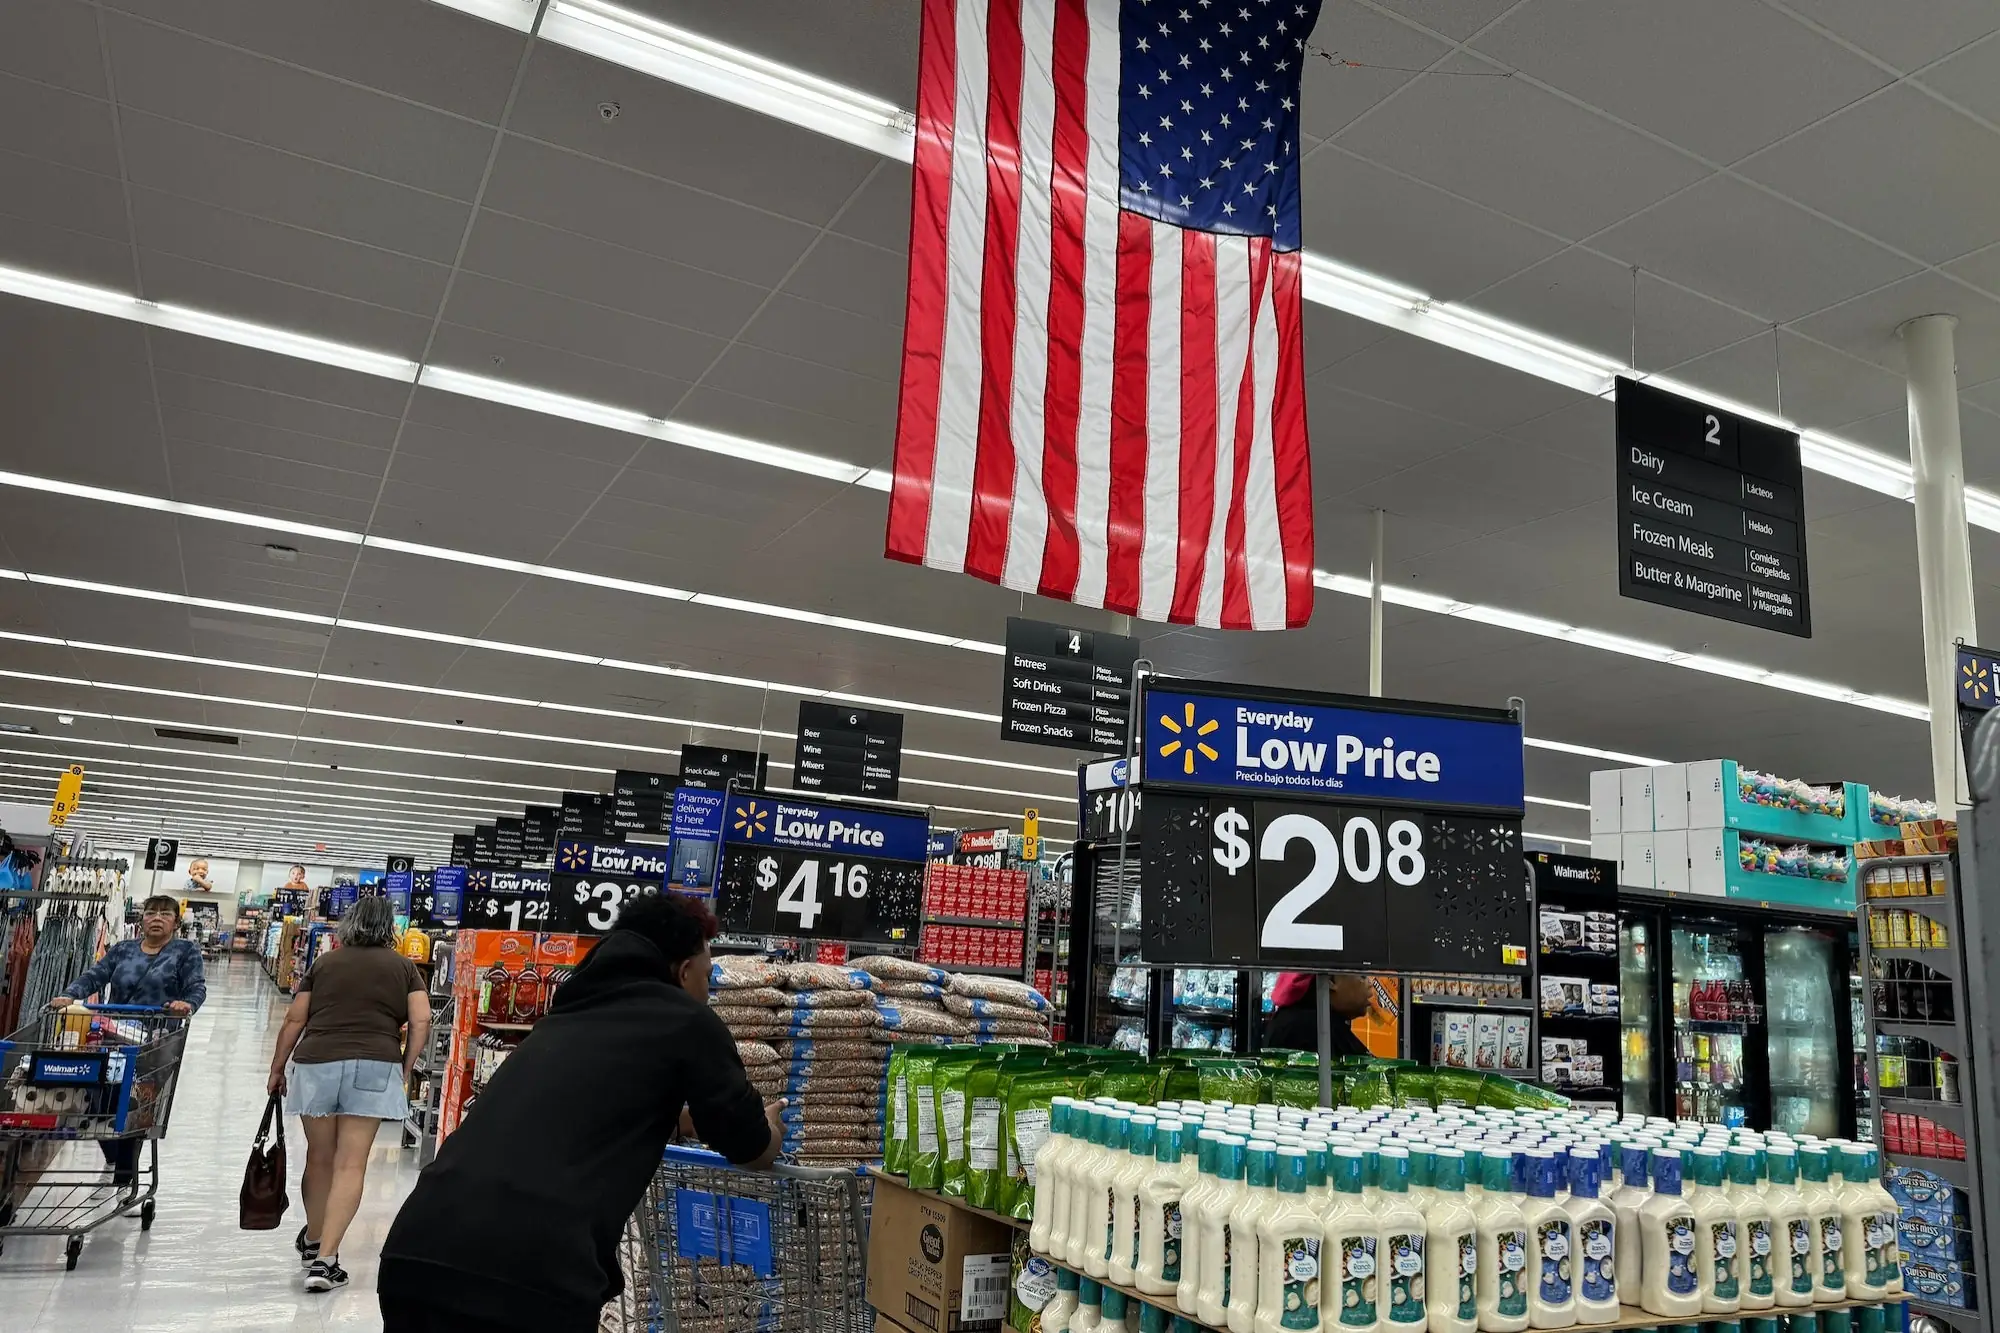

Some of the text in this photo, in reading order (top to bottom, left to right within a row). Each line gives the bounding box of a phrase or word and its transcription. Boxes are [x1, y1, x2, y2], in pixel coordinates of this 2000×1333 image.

[1705, 414, 1721, 445] 2
[1631, 447, 1665, 474] Dairy
[1746, 482, 1774, 500] Lácteos
[1632, 485, 1694, 517] Ice Cream
[1748, 520, 1773, 536] Helado
[1633, 523, 1714, 560] Frozen Meals
[1750, 550, 1780, 566] Comidas
[1750, 561, 1790, 581] Congeladas
[1635, 562, 1742, 602] Butter & Margarine
[1752, 586, 1792, 606] Mantequilla
[1752, 600, 1793, 618] y Margarina
[1068, 635, 1080, 654] 4
[1014, 656, 1047, 671] Entrees
[1012, 678, 1062, 694] Soft Drinks
[1012, 699, 1067, 716] Frozen Pizza
[850, 714, 858, 724] 6
[1236, 706, 1314, 732] Everyday
[804, 728, 820, 739] Beer
[1011, 720, 1074, 738] Frozen Snacks
[803, 744, 822, 754] Wine
[1236, 726, 1440, 782] Low Price
[722, 754, 728, 762] 8
[802, 760, 825, 770] Mixers
[684, 766, 720, 777] Snack Cakes
[1236, 770, 1344, 788] Precio bajo todos los días
[650, 778, 659, 786] 10
[684, 779, 706, 788] Tortillas
[800, 775, 822, 786] Water
[678, 792, 721, 806] Pharmacy
[57, 802, 65, 812] B
[616, 810, 638, 818] Popcorn
[676, 804, 711, 816] delivery
[777, 804, 819, 820] Everyday
[51, 814, 64, 824] 25
[676, 814, 684, 823] is
[684, 816, 704, 825] here
[774, 814, 885, 848] Low Price
[774, 836, 788, 844] Precio
[788, 838, 800, 846] bajo
[1027, 837, 1034, 845] D
[594, 846, 626, 856] Everyday
[592, 852, 630, 870] Low
[632, 856, 667, 874] Pric
[1553, 864, 1590, 880] Walmart
[490, 877, 520, 890] Low
[522, 878, 550, 892] Pric
[44, 1064, 78, 1073] Walmart
[1295, 1265, 1314, 1273] Ranch
